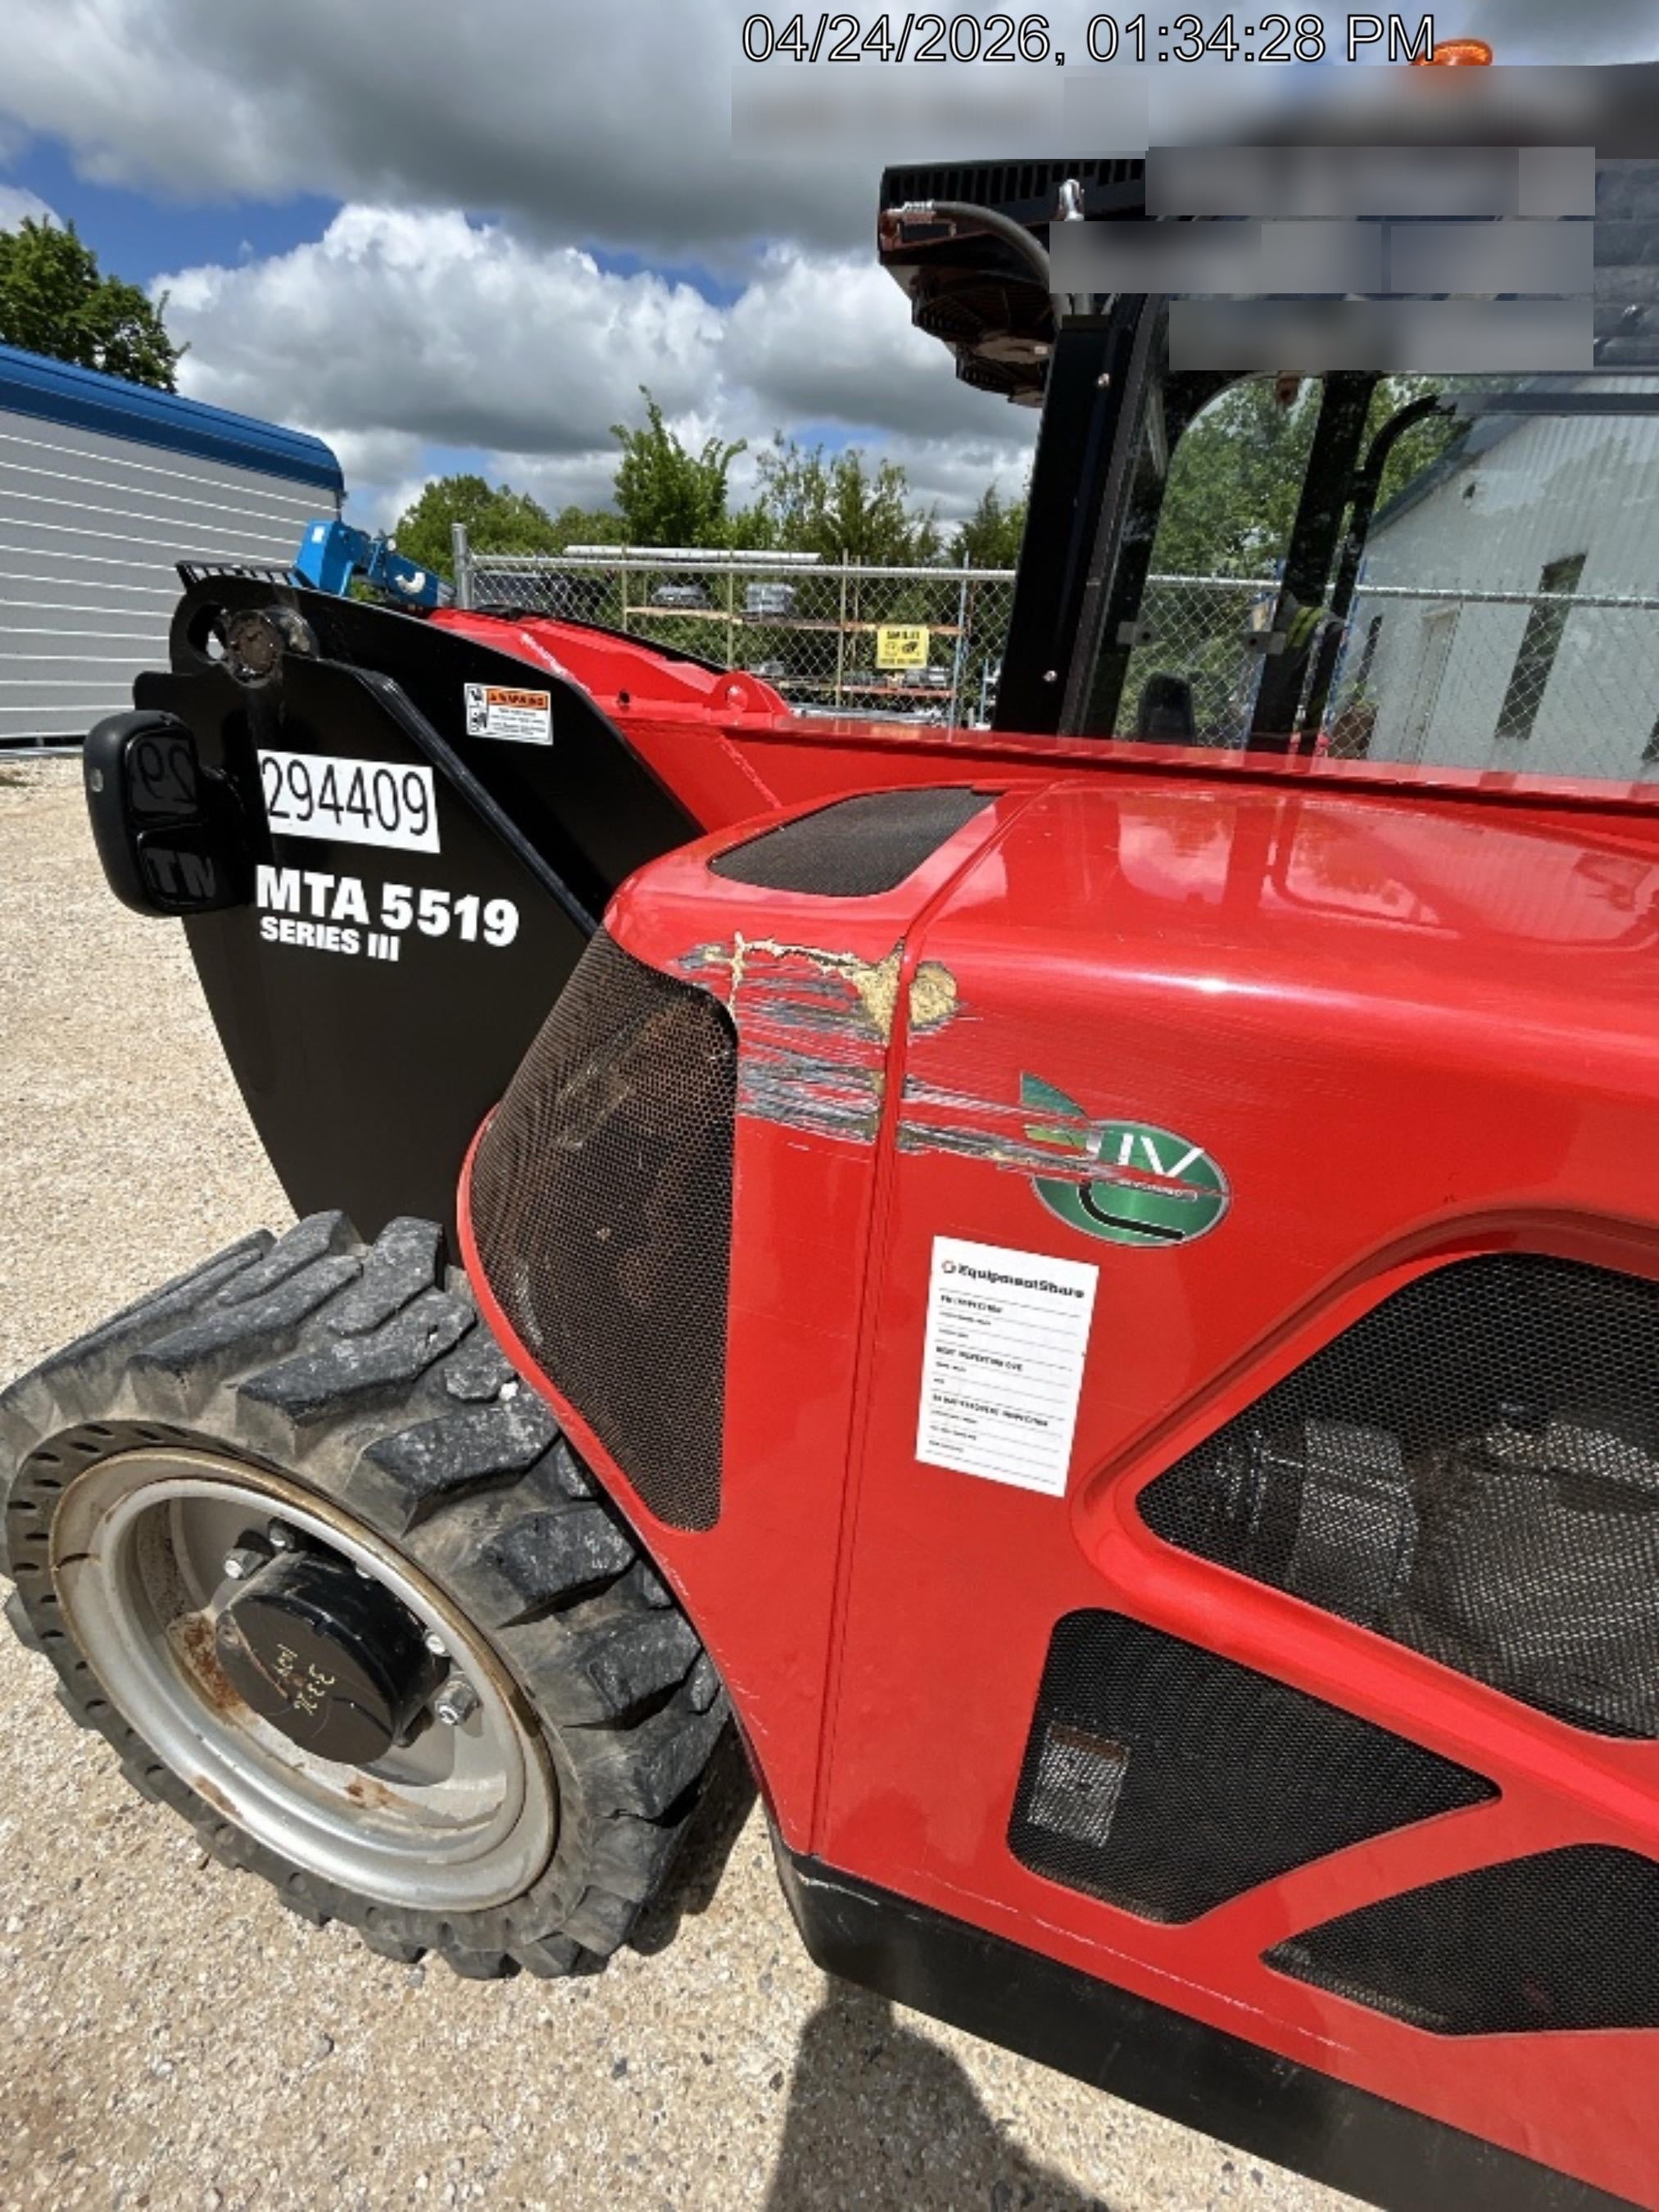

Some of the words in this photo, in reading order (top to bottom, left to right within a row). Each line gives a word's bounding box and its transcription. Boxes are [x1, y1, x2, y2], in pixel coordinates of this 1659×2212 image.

[261, 756, 430, 836] 294409
[256, 864, 370, 925] MTA
[380, 882, 519, 947] 5519
[260, 916, 360, 954] SERIES
[367, 932, 400, 962] III
[958, 1263, 1085, 1299] EquipmentShare
